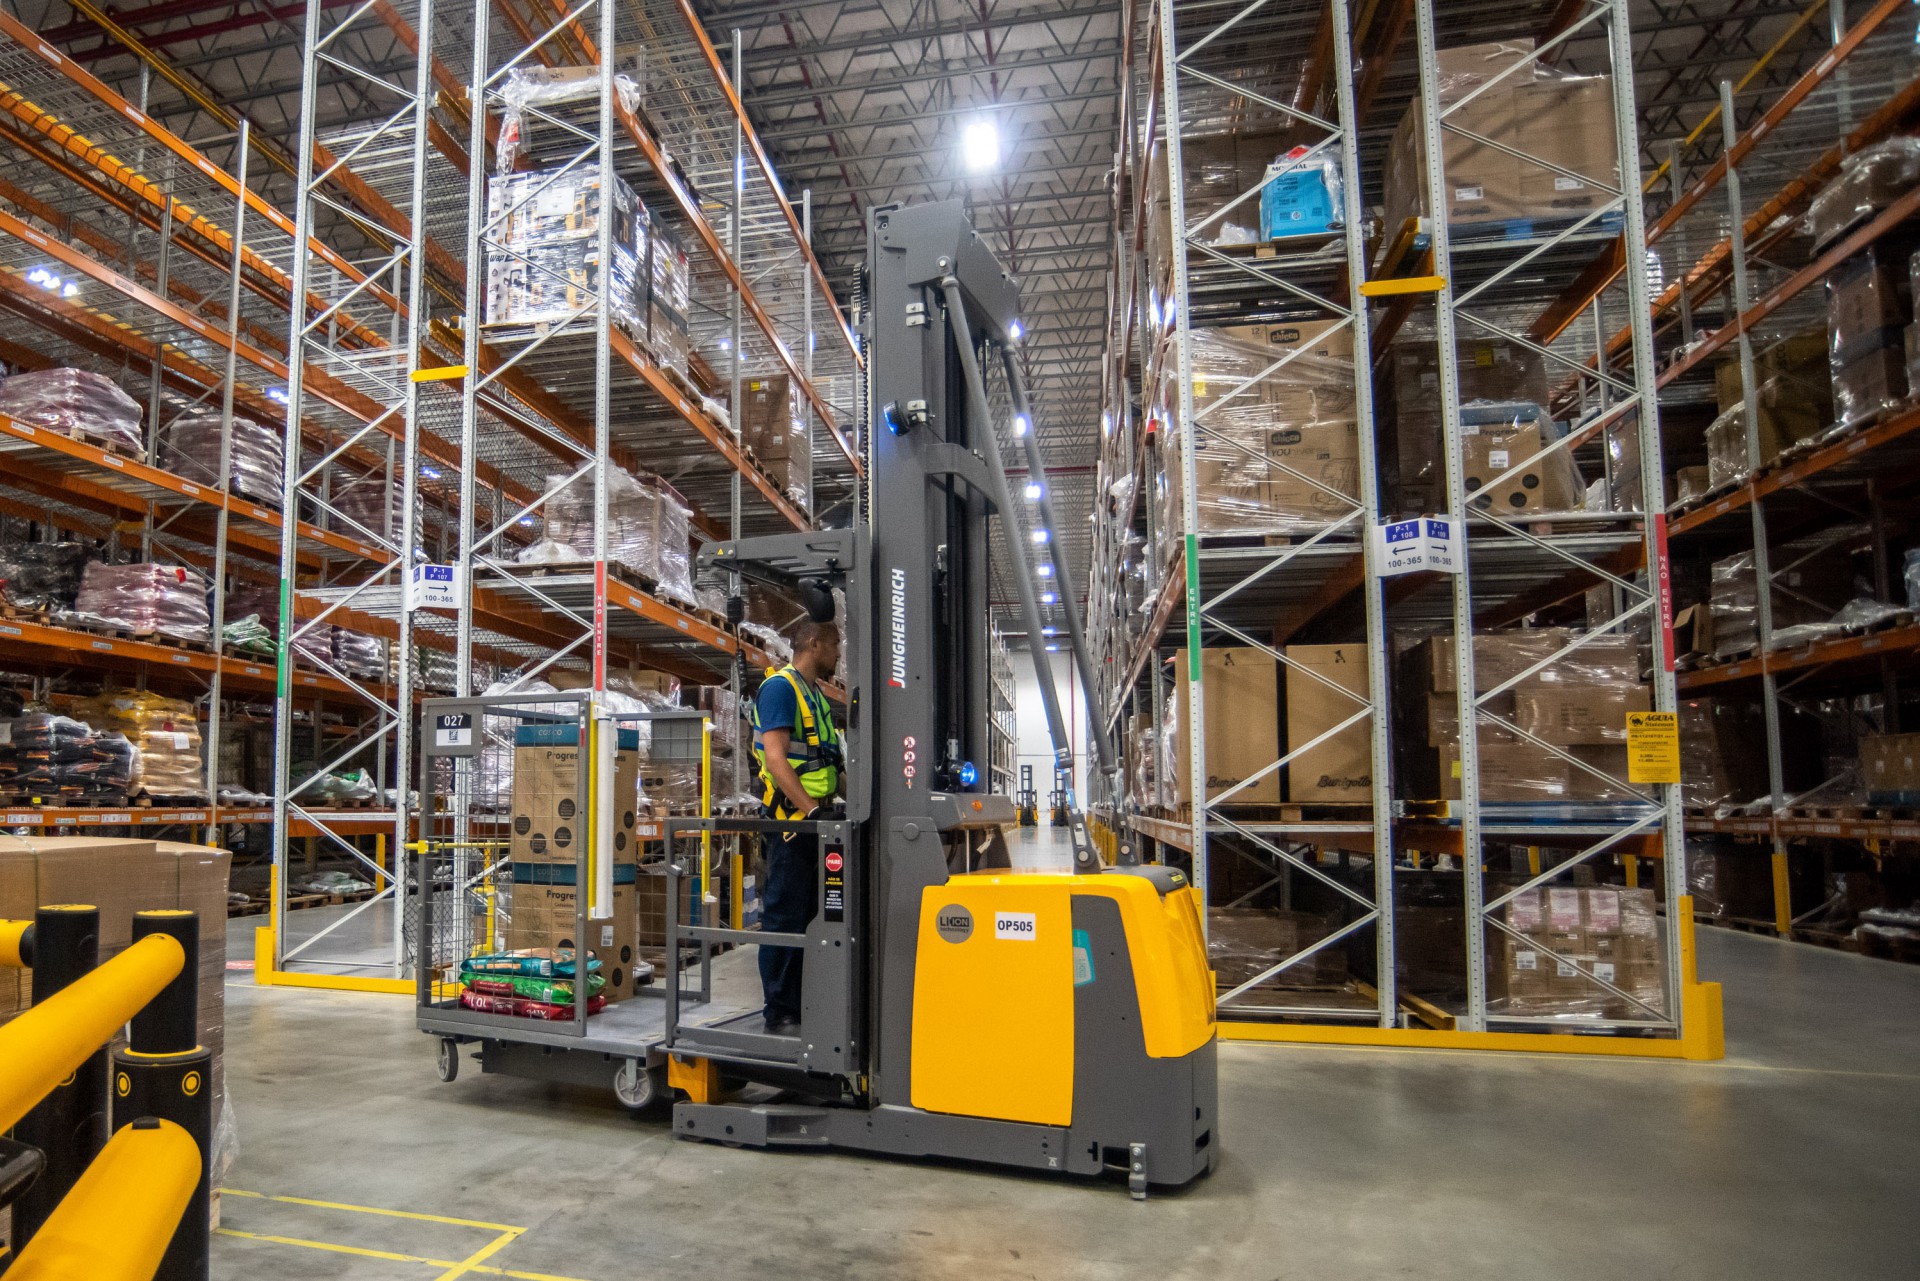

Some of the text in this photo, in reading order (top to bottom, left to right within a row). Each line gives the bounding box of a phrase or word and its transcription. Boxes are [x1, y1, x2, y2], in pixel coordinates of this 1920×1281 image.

[1272, 331, 1299, 342] chicco
[1395, 524, 1409, 533] P-1
[1433, 522, 1443, 530] P-1
[1401, 531, 1413, 539] 108
[1388, 556, 1422, 568] 100-365
[1429, 556, 1452, 566] 100-365
[1659, 555, 1668, 579] NÃO
[424, 594, 454, 603] 100-365
[1661, 588, 1670, 629] ENTRE
[888, 568, 906, 689] JUNGHEINRICH
[444, 715, 464, 727] 027
[1645, 714, 1674, 722] ÁGUIA
[997, 919, 1033, 932] OP505
